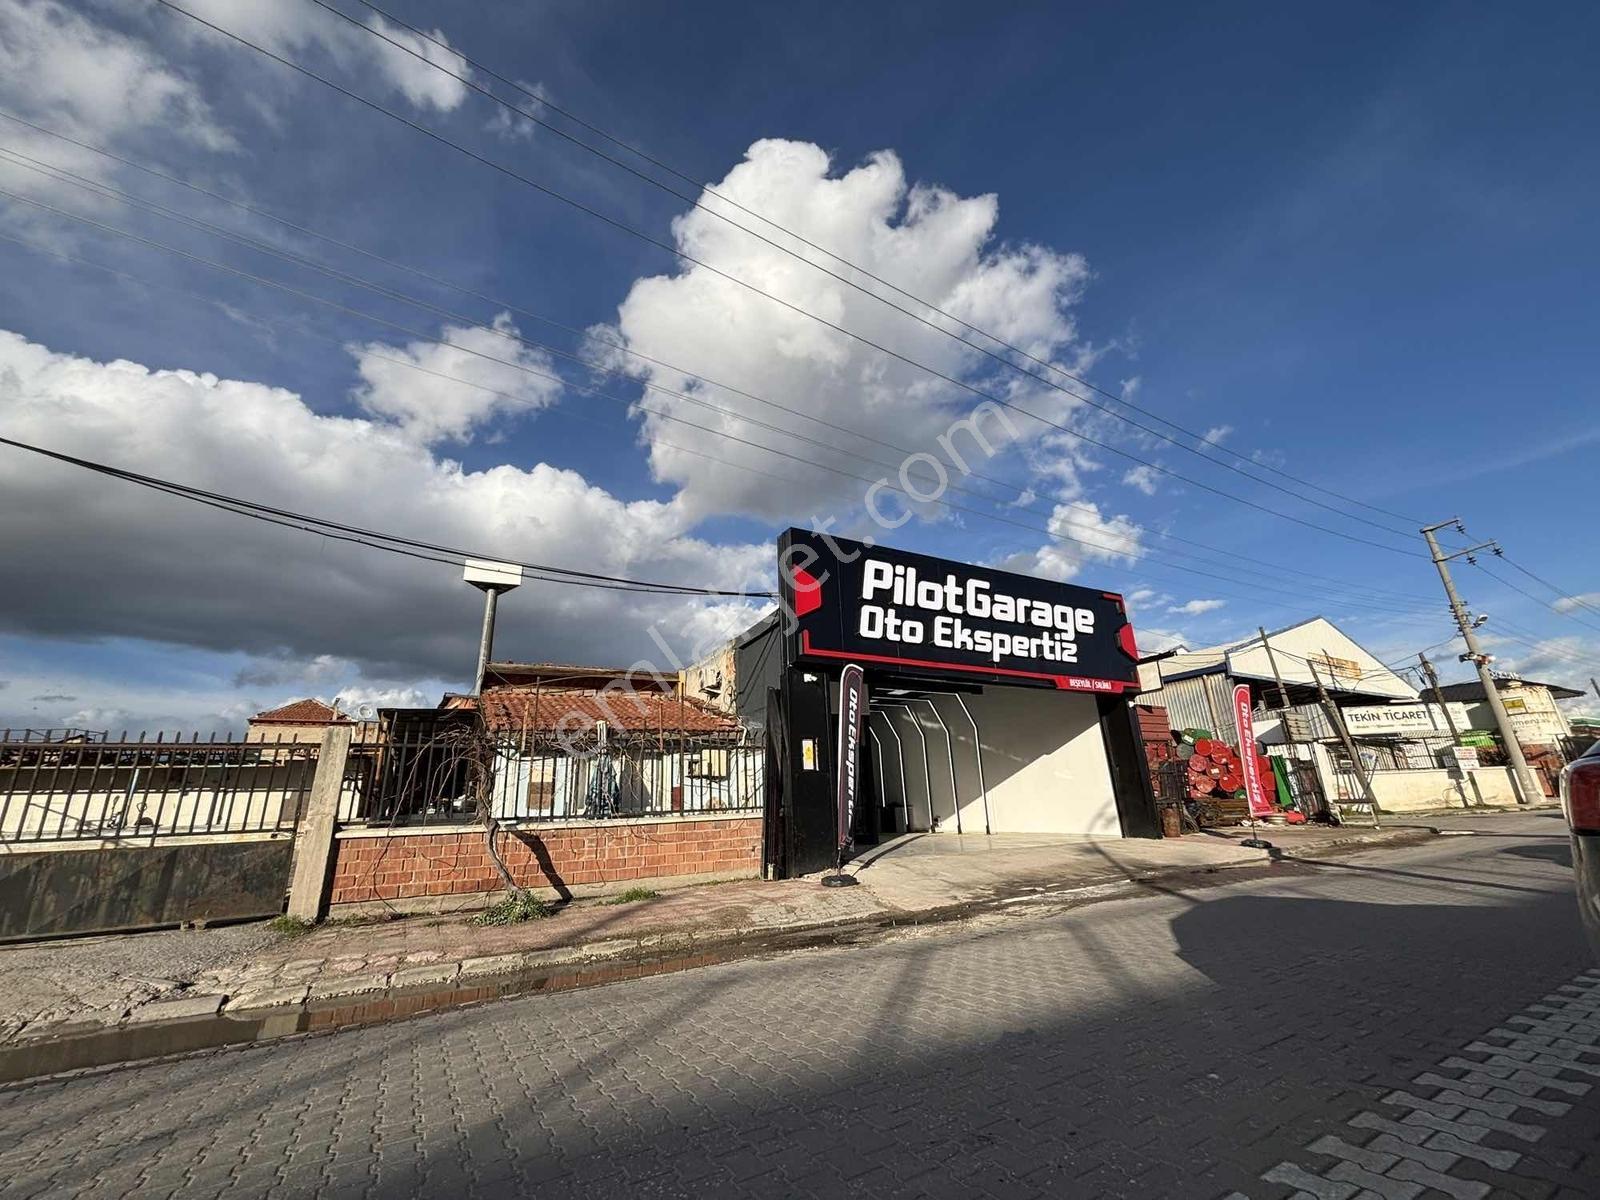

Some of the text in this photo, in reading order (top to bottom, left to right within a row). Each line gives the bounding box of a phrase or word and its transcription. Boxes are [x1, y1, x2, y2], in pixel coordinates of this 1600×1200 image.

[861, 558, 1095, 642] PilotGarage
[859, 604, 1078, 663] Oto Ekspertiz
[1240, 701, 1249, 728] Oto
[1347, 710, 1381, 722] TEKİN
[1384, 709, 1428, 721] TİCARET
[845, 687, 858, 832] Oto Eksperti
